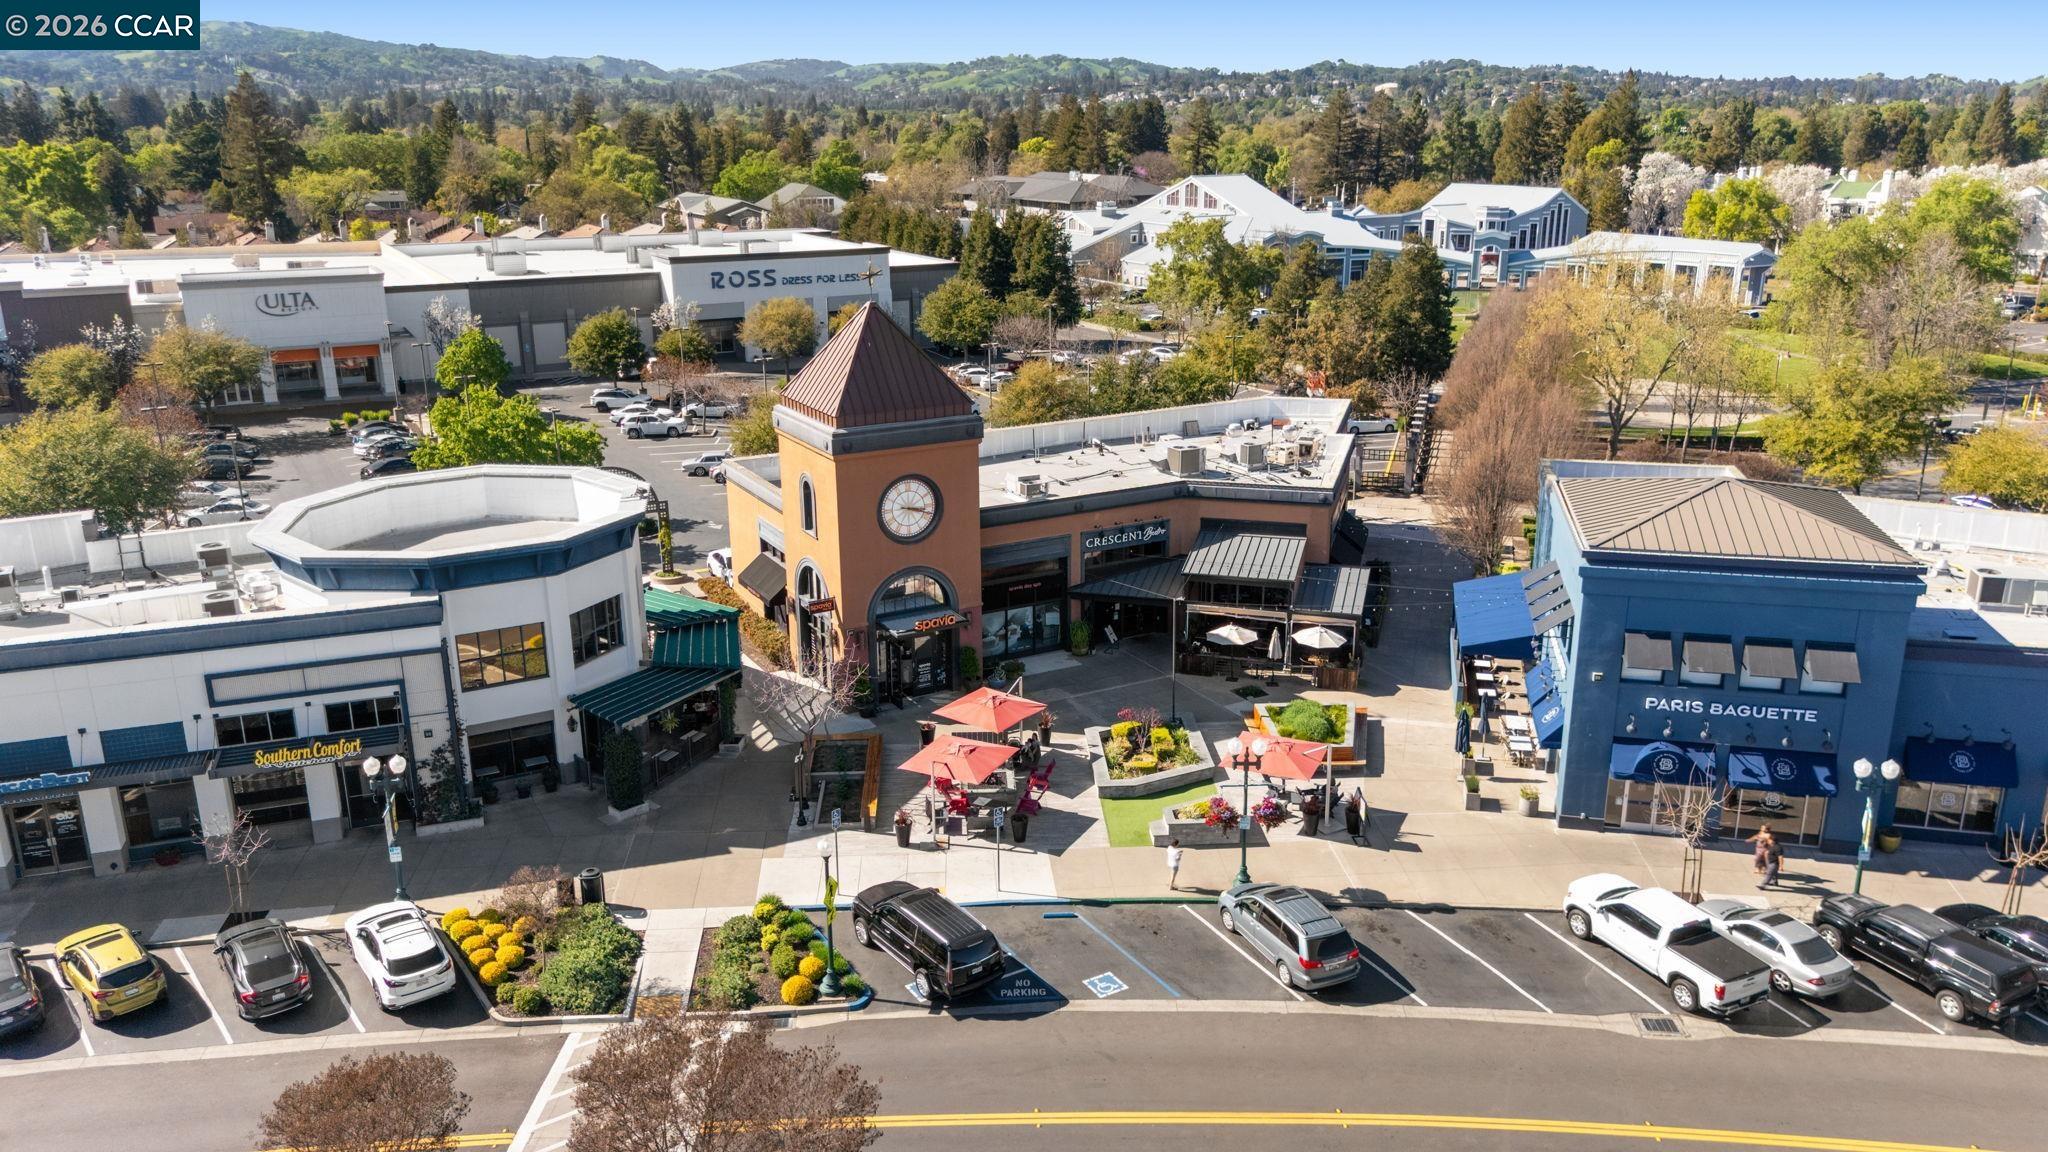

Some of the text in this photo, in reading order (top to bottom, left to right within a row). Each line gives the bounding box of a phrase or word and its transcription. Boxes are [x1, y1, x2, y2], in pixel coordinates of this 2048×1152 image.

[710, 269, 777, 289] ROSS
[781, 275, 813, 286] DRESS
[816, 274, 836, 283] FOR
[263, 291, 316, 309] ULTA
[1085, 530, 1142, 548] CRESCENT
[913, 614, 956, 632] spavia
[1645, 697, 1818, 723] PARIS BAGUETTE
[254, 738, 362, 767] Southern Comfort
[1015, 979, 1031, 988] NO
[1000, 988, 1047, 998] PARKING
